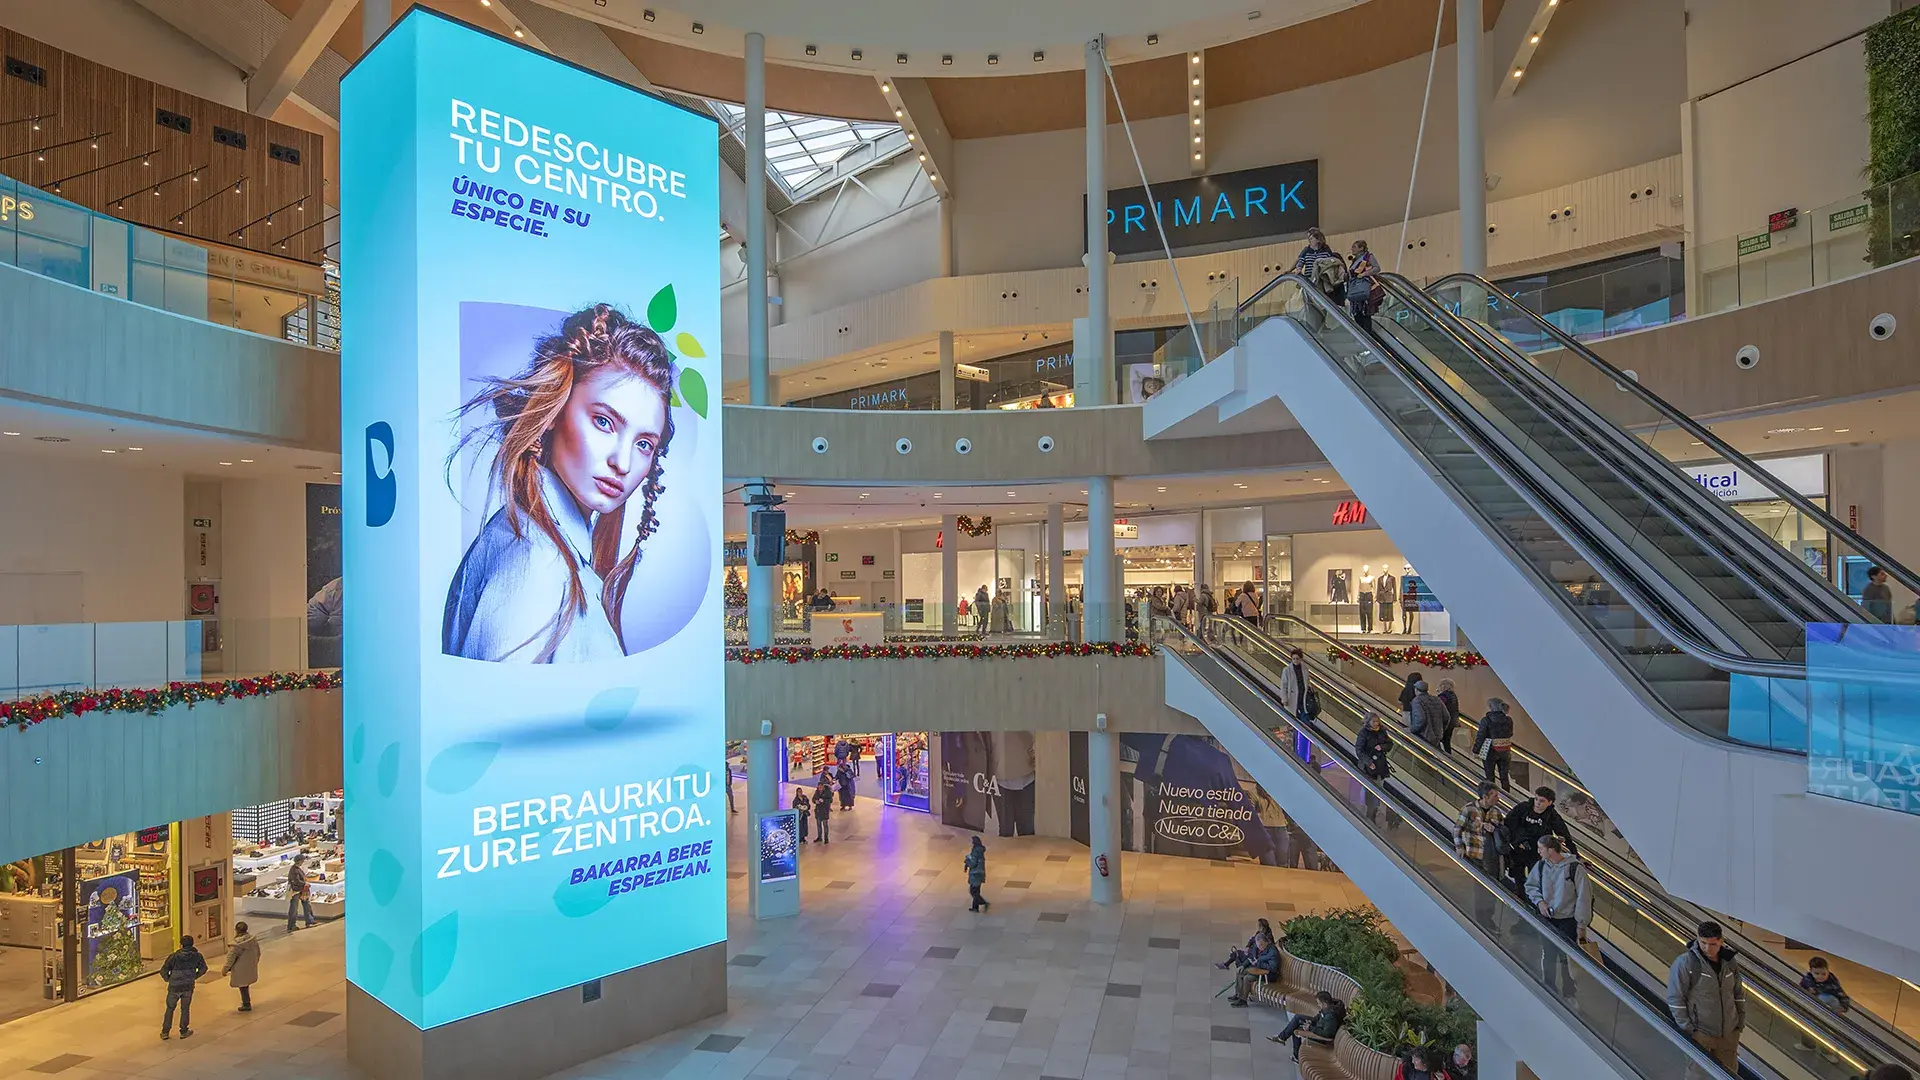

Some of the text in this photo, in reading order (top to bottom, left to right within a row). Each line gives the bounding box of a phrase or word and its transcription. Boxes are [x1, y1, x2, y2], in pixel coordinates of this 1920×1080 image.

[451, 98, 686, 198] REDESCUBRE
[450, 133, 665, 222] TU CENTRO.
[452, 175, 591, 228] ÚNICO EN SU
[1833, 207, 1864, 221] SALIDA DE
[451, 199, 549, 238] ESPECIE.
[1740, 237, 1759, 248] SALIDA
[850, 388, 907, 410] PRIMARK
[1332, 500, 1367, 525] H&M
[973, 772, 1002, 797] C&A
[1158, 782, 1243, 802] Nuevo estilo
[473, 771, 711, 836] BERRAURKITU
[1158, 799, 1253, 821] Nueva tienda
[436, 803, 712, 879] ZURE ZENTROA.
[1159, 819, 1243, 841] Nuevo C&A
[569, 840, 713, 885] BAKARRA BERE
[608, 860, 712, 896] ESPEZIEAN.
